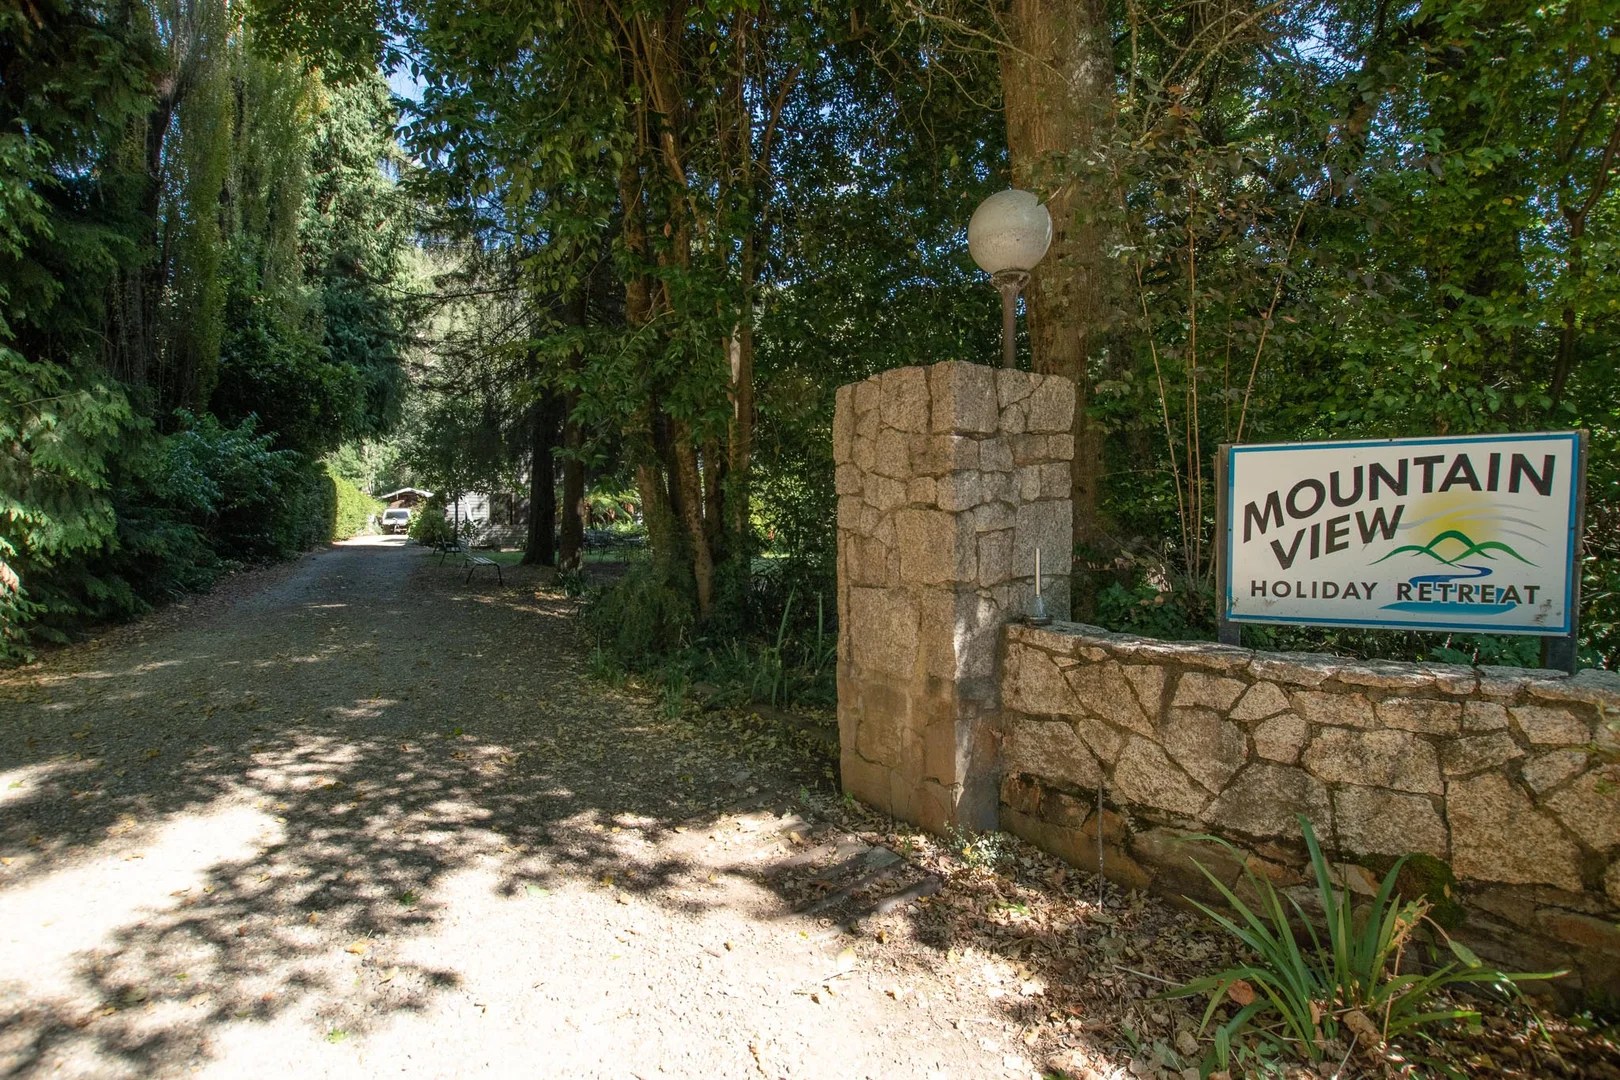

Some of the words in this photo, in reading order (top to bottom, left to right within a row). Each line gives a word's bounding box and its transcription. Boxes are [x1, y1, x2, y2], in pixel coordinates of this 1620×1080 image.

[1243, 452, 1556, 544] MOUNTAIN
[1269, 504, 1406, 571] VIEW
[1250, 579, 1378, 600] HOLIDAY
[1396, 582, 1541, 605] RETREAT
